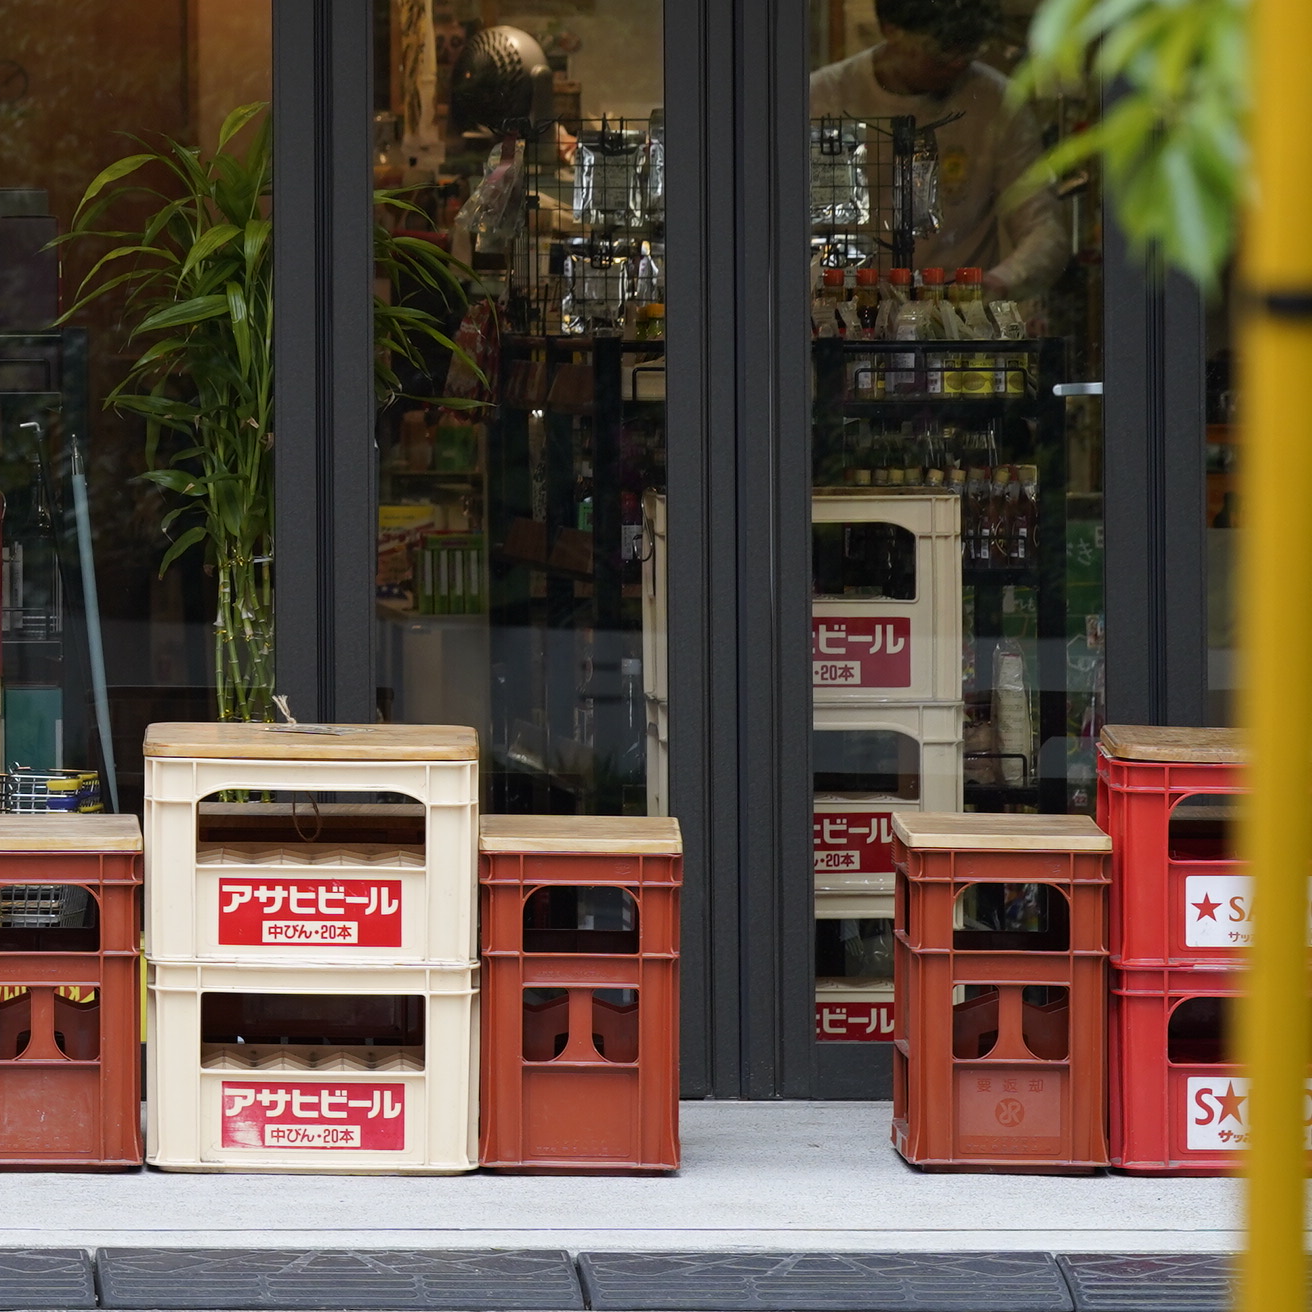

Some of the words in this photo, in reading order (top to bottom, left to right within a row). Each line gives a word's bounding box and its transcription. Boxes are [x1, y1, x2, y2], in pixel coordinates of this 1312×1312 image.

[222, 884, 399, 916] アサヒビール
[268, 924, 353, 940] 中びん・20本
[976, 1078, 1044, 1093] 要返却
[224, 1088, 402, 1119] アサヒビール
[270, 1127, 355, 1143] 中びん・20本
